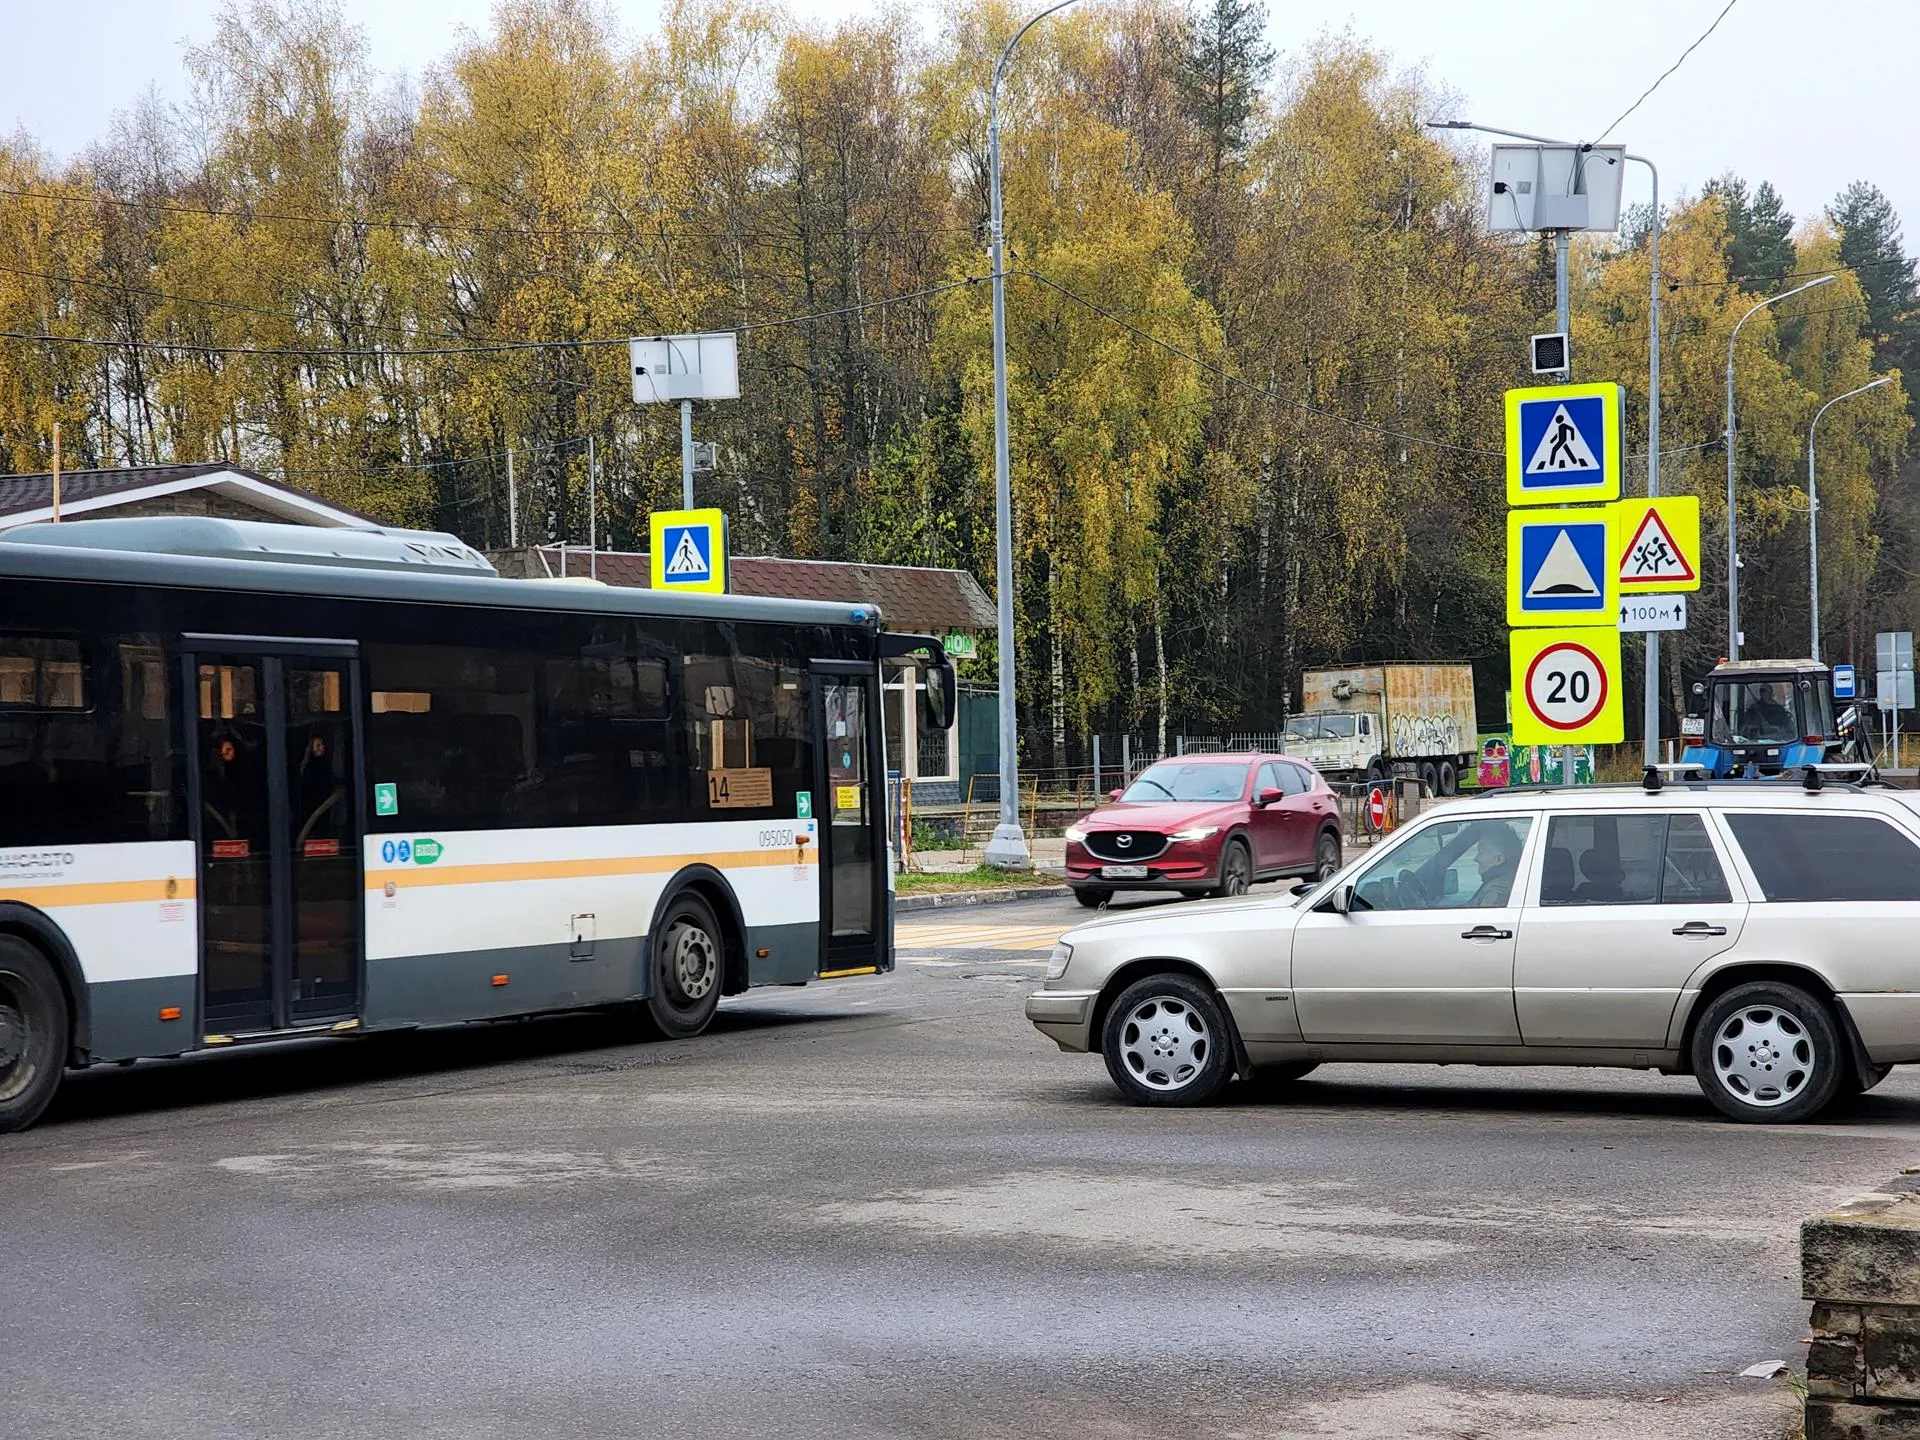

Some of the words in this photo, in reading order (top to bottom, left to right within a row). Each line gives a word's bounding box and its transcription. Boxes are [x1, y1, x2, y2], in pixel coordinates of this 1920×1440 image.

[1546, 670, 1590, 704] 20
[710, 776, 730, 804] 14
[759, 829, 793, 847] 095050
